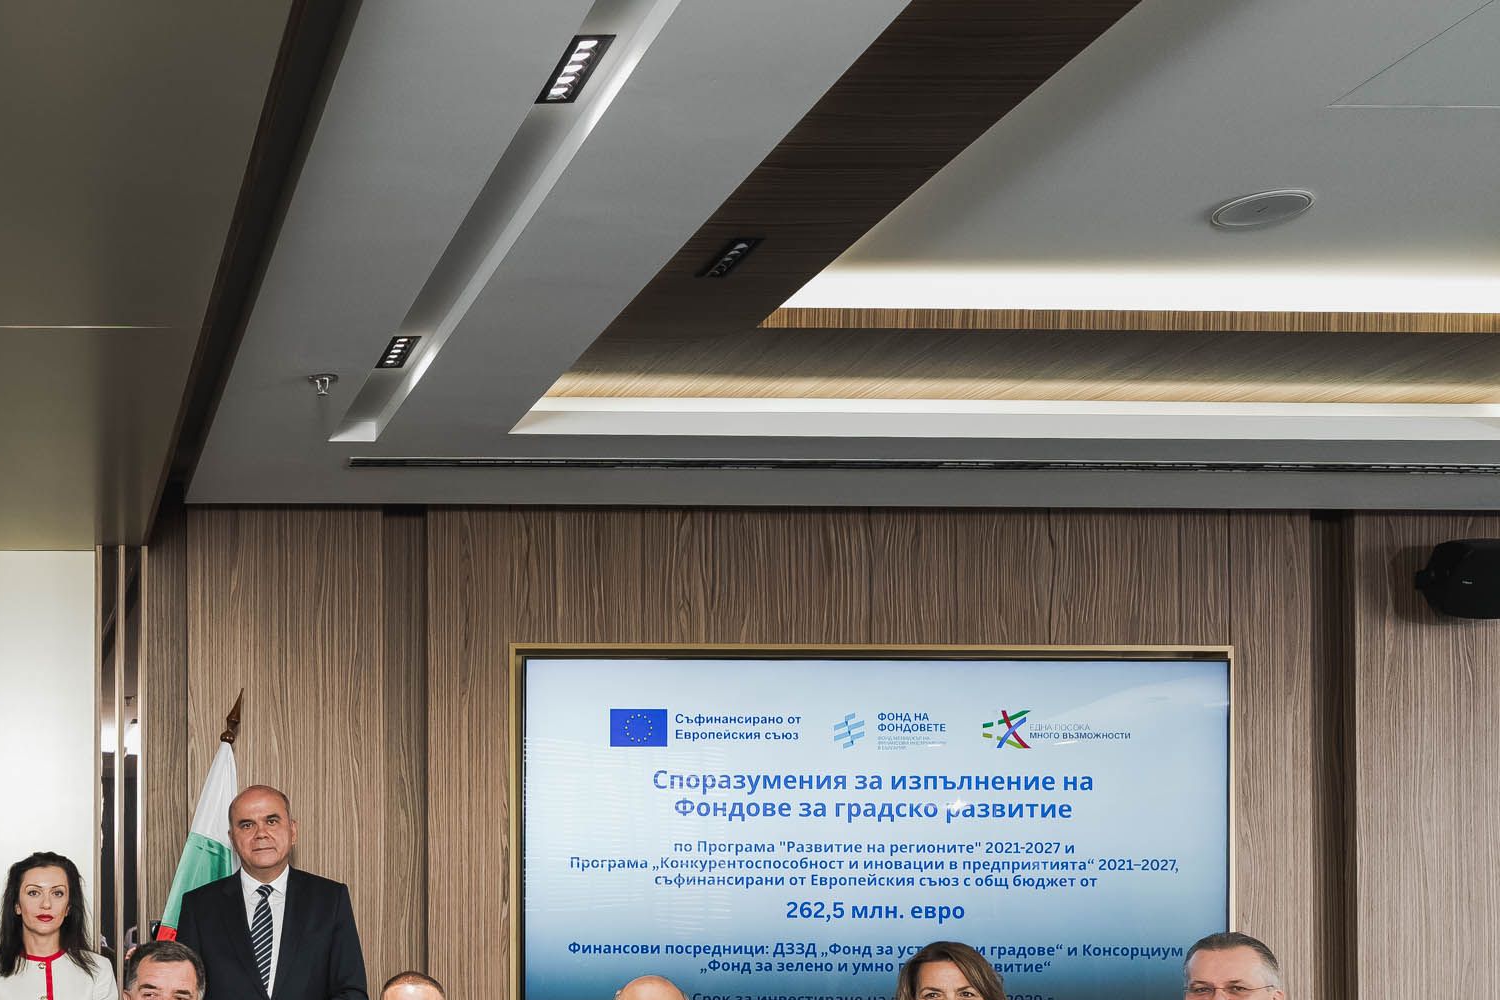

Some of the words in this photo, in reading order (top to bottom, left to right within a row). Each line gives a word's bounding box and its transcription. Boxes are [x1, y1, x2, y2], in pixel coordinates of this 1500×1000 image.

[675, 713, 784, 727] Съфинансирано
[787, 716, 802, 725] от
[877, 712, 912, 723] ФОНД
[914, 712, 930, 722] НА
[675, 729, 761, 742] Европейския
[764, 731, 799, 741] съюз
[877, 722, 946, 734] ФОНДОВЕТЕ
[1029, 732, 1060, 740] МНОГО
[1062, 731, 1131, 740] ВЪЗМОЖНОСТИ
[653, 769, 847, 796] Споразумения
[854, 774, 883, 790] за
[891, 775, 1056, 791] изпълнение
[1063, 775, 1093, 791] на
[674, 797, 792, 822] Фондове
[798, 802, 827, 818] за
[835, 802, 939, 824] градско
[946, 803, 1073, 824] развитие
[674, 843, 693, 852] по
[697, 840, 775, 857] Програма
[779, 840, 863, 853] "Развитие
[866, 843, 885, 854] на
[889, 841, 981, 857] регионите"
[985, 841, 1061, 854] 2021-2027
[1064, 844, 1075, 855] и
[570, 856, 648, 873] Програма
[848, 860, 859, 870] и
[863, 860, 945, 873] иновации
[949, 860, 958, 870] в
[654, 872, 785, 890] съфинансирани
[789, 876, 807, 886] от
[811, 873, 915, 890] Европейския
[919, 876, 960, 887] съюз
[963, 877, 971, 887] с
[974, 874, 1009, 890] общ
[1012, 874, 1077, 890] бюджет
[1079, 877, 1098, 888] от
[786, 901, 845, 923] 262,5
[851, 905, 904, 919] млн.
[910, 905, 965, 925] евро
[567, 941, 661, 955] Финансови
[664, 944, 769, 959] посредници:
[772, 942, 818, 959] ДЗЗД
[875, 945, 894, 956] за
[1067, 946, 1078, 957] и
[1082, 943, 1183, 961] Консорциум
[754, 961, 773, 972] за
[776, 961, 834, 973] зелено
[837, 962, 848, 973] и
[851, 962, 894, 976] умно
[993, 960, 1051, 973] витие“
